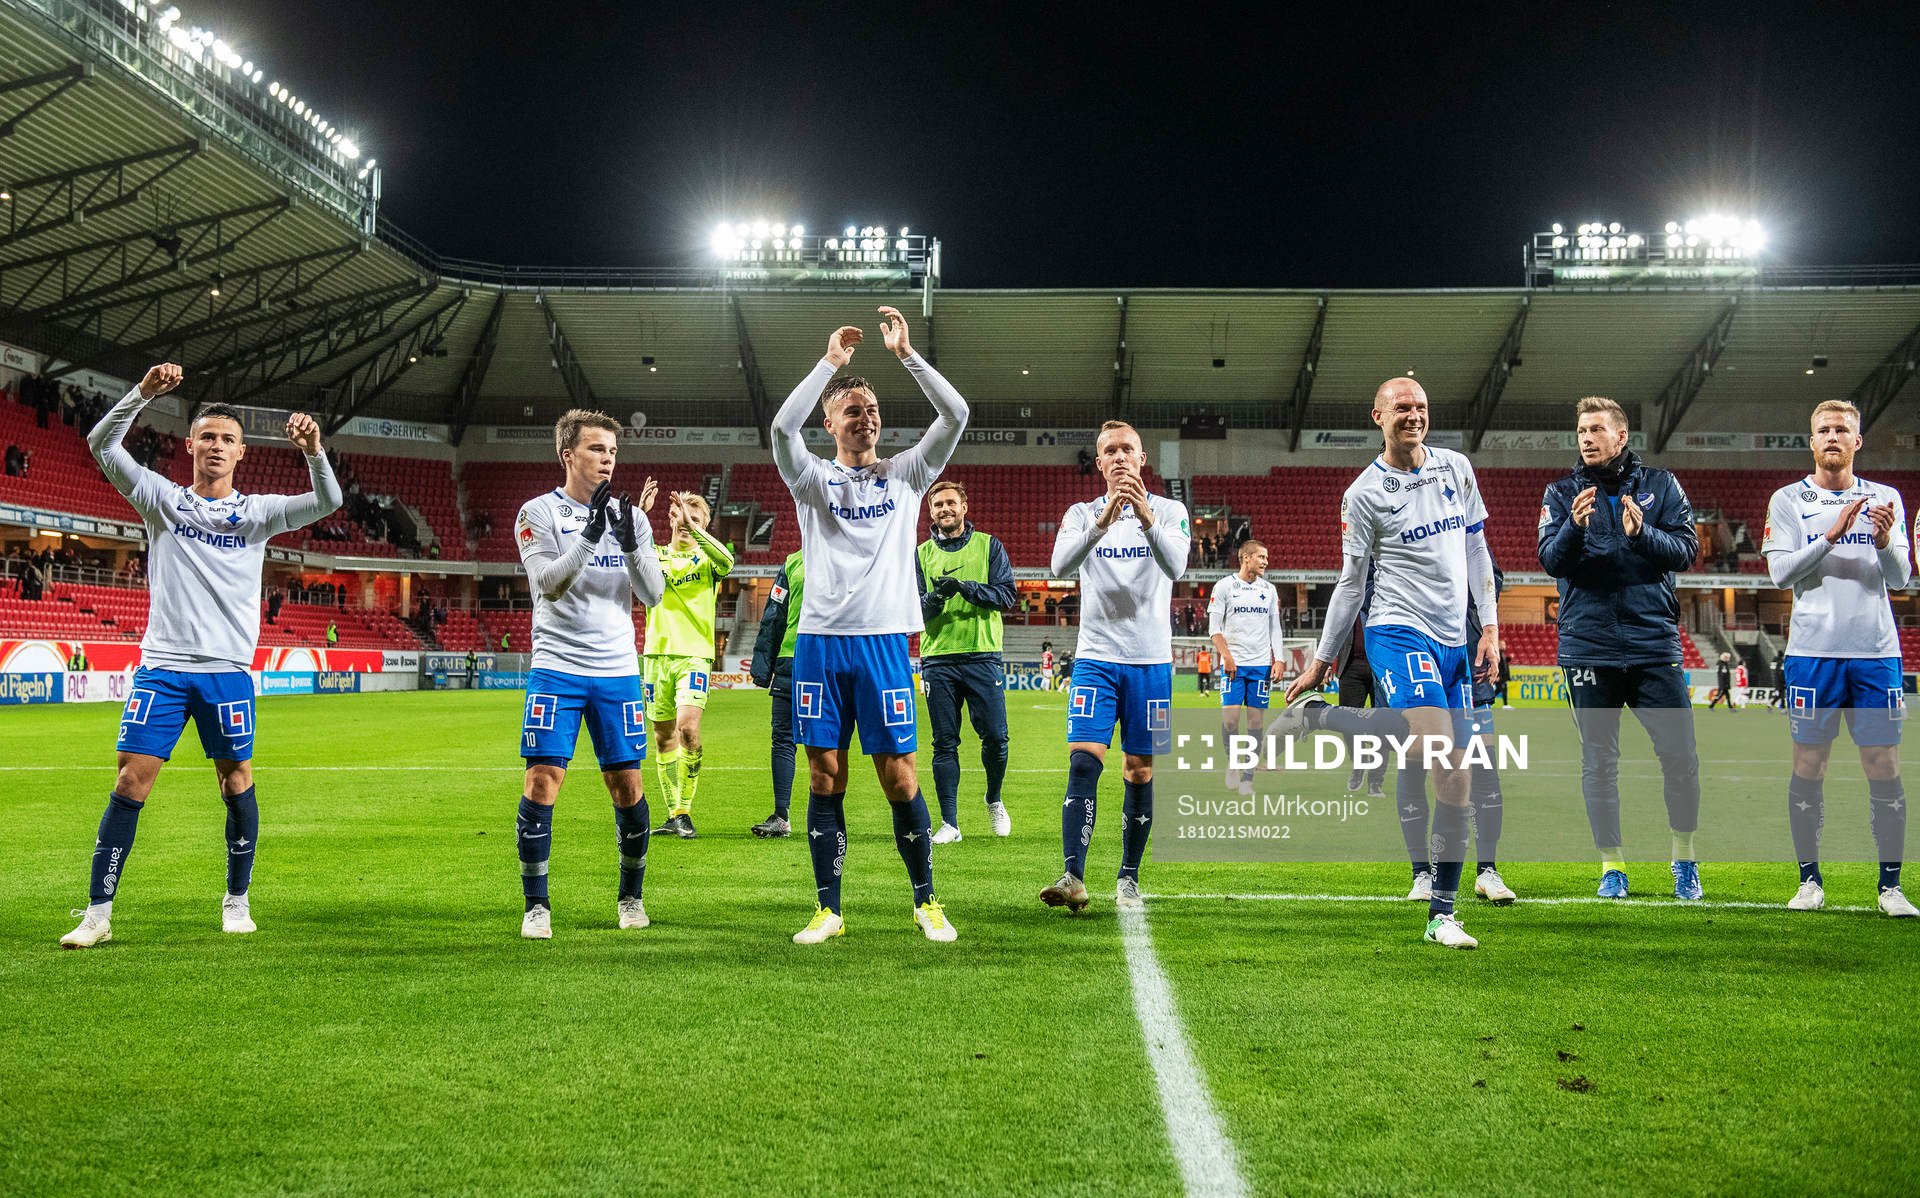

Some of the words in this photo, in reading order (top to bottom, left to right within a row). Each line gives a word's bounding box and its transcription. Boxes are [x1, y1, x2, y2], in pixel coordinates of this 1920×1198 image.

[358, 422, 379, 434] INFO
[392, 424, 428, 439] SERVICE
[620, 428, 677, 439] EVEGO
[1763, 436, 1811, 449] PEA
[1404, 476, 1438, 492] stadium
[828, 498, 896, 520] HOLMEN
[174, 523, 247, 548] HOLMEN
[1400, 514, 1466, 544] HOLMEN
[1807, 533, 1875, 545] HMEN
[588, 555, 627, 567] MEN
[1234, 606, 1269, 614] HOLMEN
[429, 656, 454, 670] Guld
[1010, 663, 1042, 675] Fågel
[494, 677, 528, 687] SPORTDO
[711, 674, 743, 684] RSONS
[1511, 673, 1549, 682] AMIRENT
[1571, 668, 1597, 687] 24
[9, 674, 45, 703] Fågeln
[1415, 684, 1425, 698] 4
[1521, 683, 1555, 700] CITY
[524, 732, 536, 748] 10
[109, 847, 123, 873] suez
